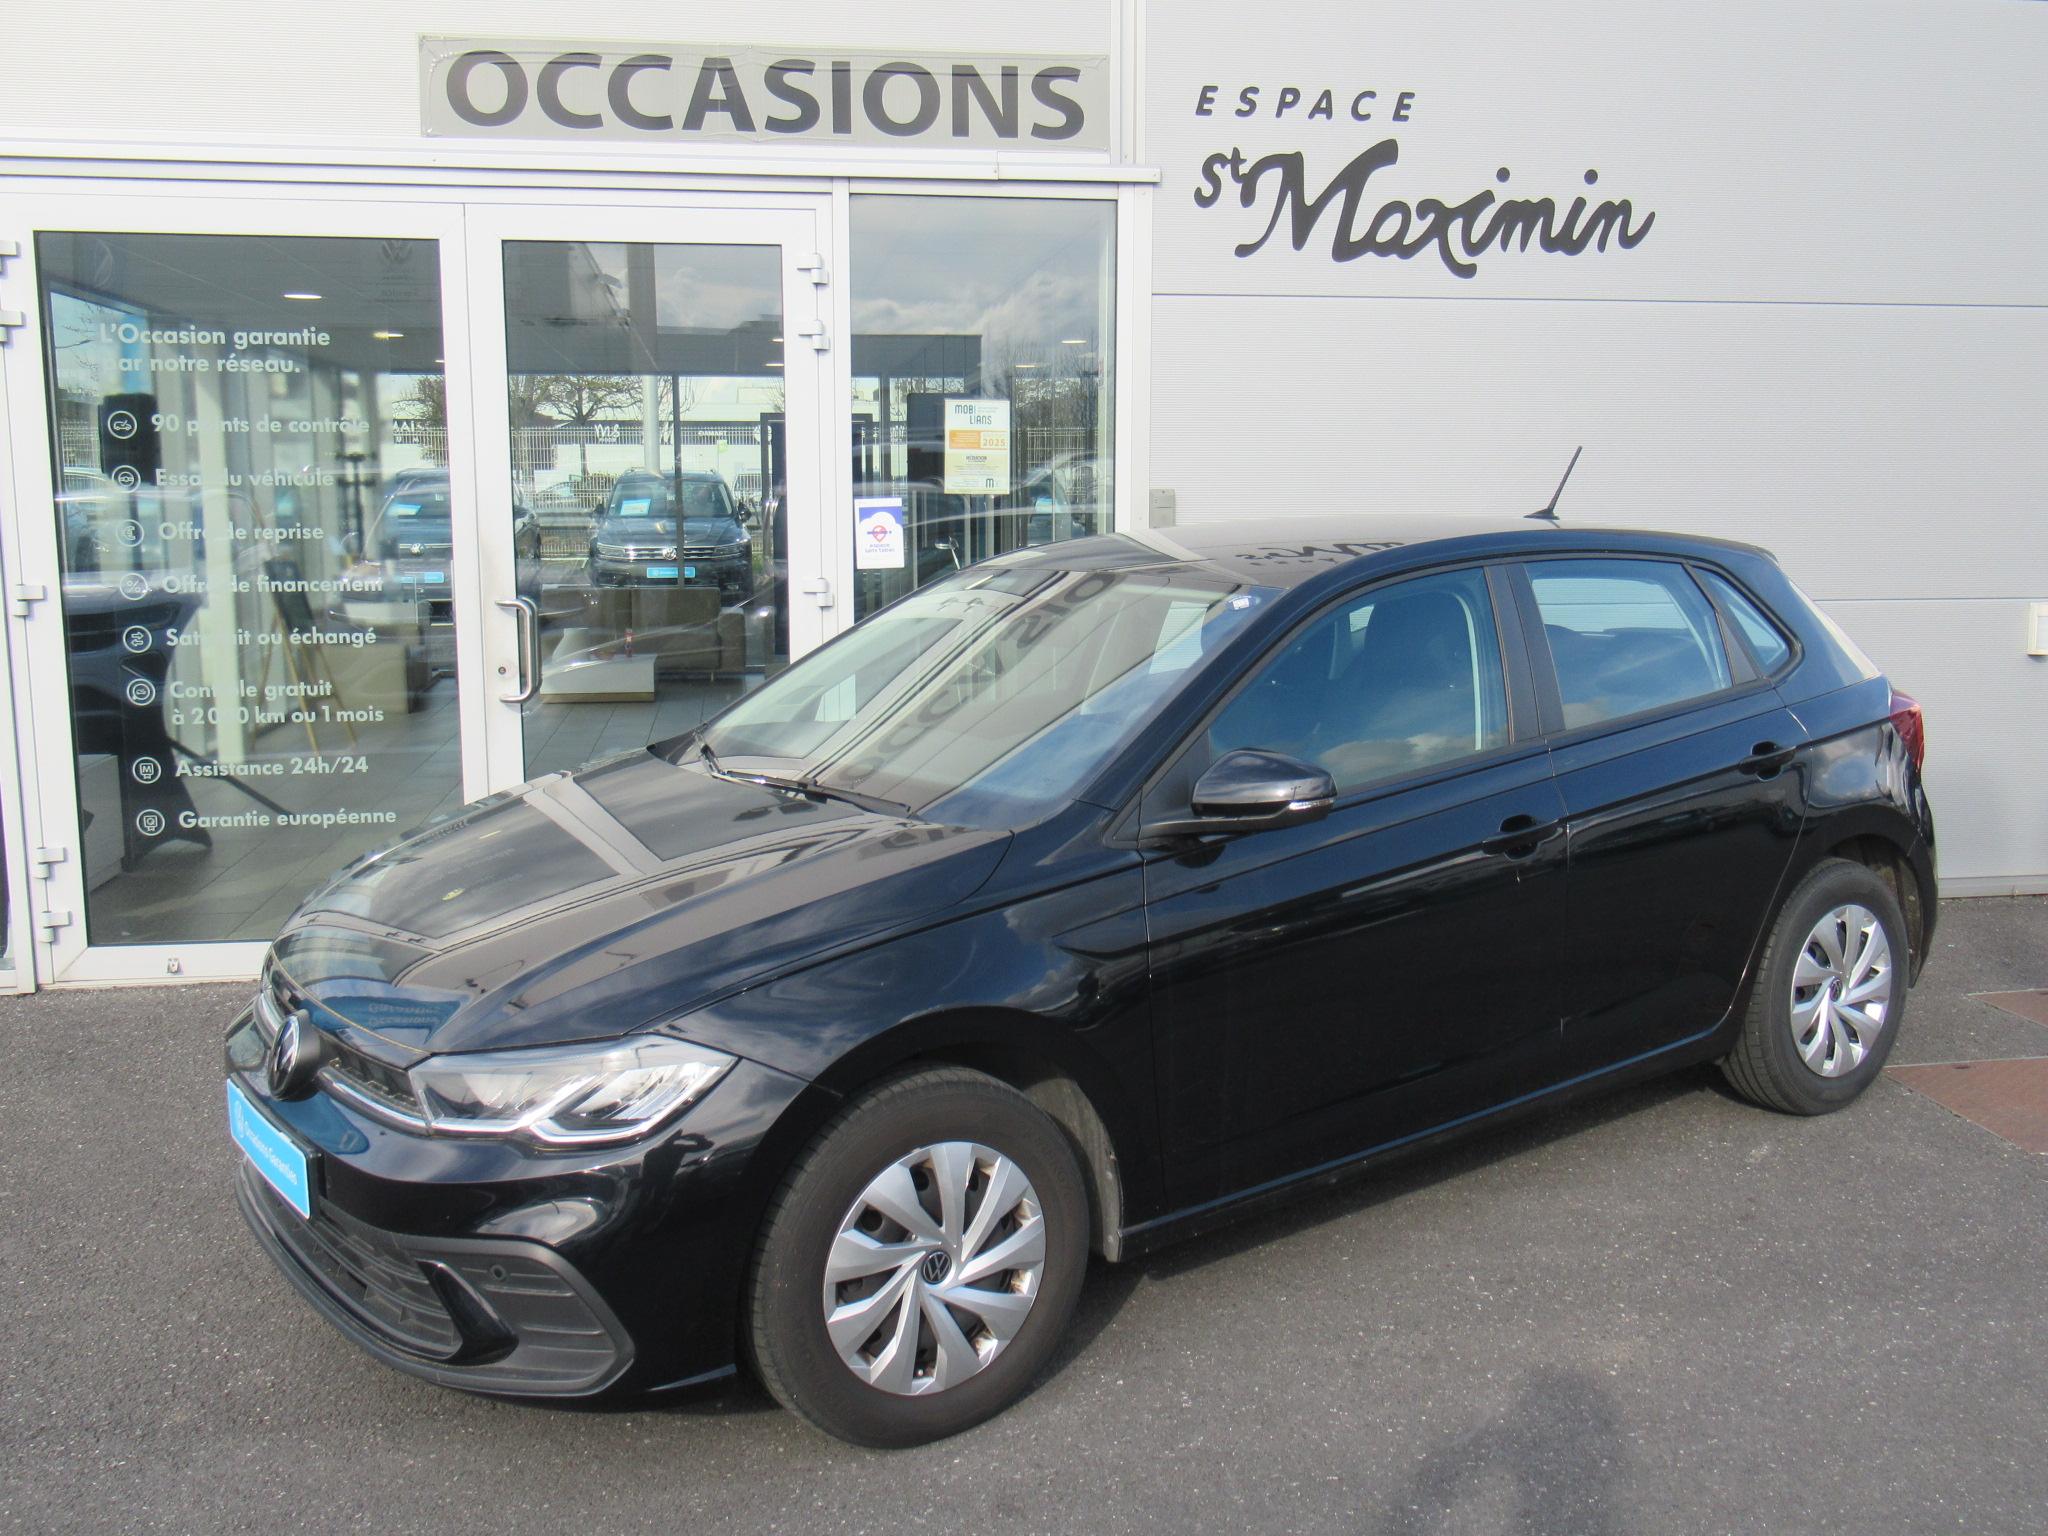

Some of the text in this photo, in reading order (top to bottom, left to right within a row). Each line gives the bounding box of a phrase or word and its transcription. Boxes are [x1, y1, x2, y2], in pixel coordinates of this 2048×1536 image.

[446, 50, 1086, 141] OCCASIONS
[1195, 85, 1416, 122] ESPACE
[1234, 138, 1656, 279] Maximin
[233, 325, 331, 350] garantie
[103, 353, 300, 376] ar notre réseau.
[151, 413, 180, 433] 90
[187, 416, 250, 436] pnts
[257, 413, 282, 433] de
[288, 413, 370, 433] contrôle
[156, 468, 204, 487] Essa
[248, 467, 334, 487] véhicule
[254, 521, 324, 545] reprise
[163, 574, 215, 594] Offr
[257, 574, 384, 594] financement
[166, 626, 377, 648] Satit ou échangé
[264, 680, 333, 701] gratuit
[172, 708, 185, 725] à
[255, 705, 286, 724] km
[291, 708, 315, 723] ou
[321, 706, 330, 722] 1
[336, 706, 384, 722] mois
[175, 756, 369, 777] Assistance 24h/24
[179, 808, 397, 829] Garantie européenne
